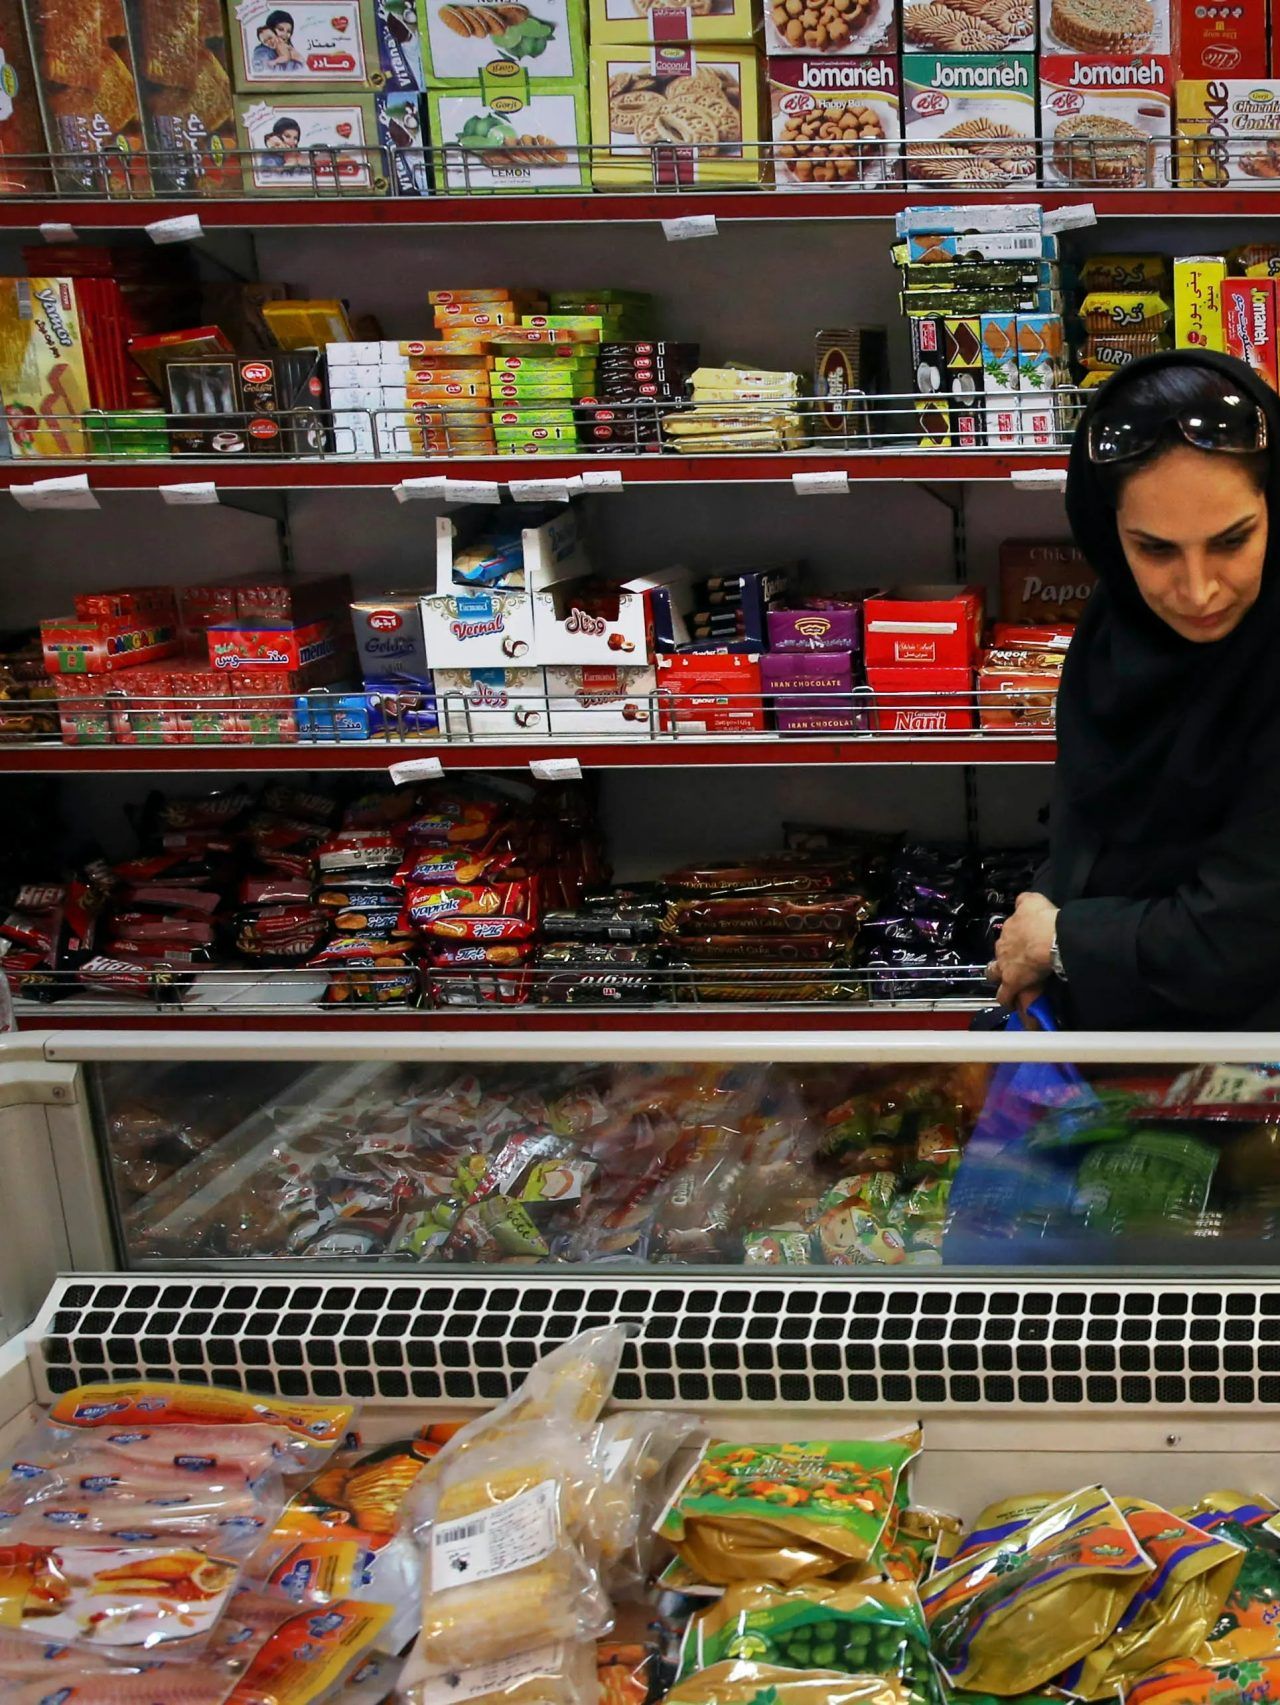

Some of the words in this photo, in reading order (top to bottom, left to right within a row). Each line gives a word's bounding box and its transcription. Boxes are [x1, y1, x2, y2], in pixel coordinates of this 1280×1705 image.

[306, 38, 337, 51] ممتاز
[311, 55, 351, 70] مادر
[655, 60, 689, 71] Coconut
[1203, 47, 1240, 67] Elite
[797, 63, 895, 89] Jomaneh
[930, 61, 1028, 88] Jomaneh
[1068, 63, 1164, 87] Jomaneh
[490, 167, 531, 178] LEMON
[1112, 303, 1144, 326] ترد
[1252, 287, 1269, 346] Jomaneh
[1237, 313, 1253, 365] یسکویت
[1096, 346, 1134, 365] TORD
[452, 613, 505, 640] Vernal
[565, 608, 607, 636] ورنال
[365, 638, 416, 654] Golden
[214, 650, 290, 670] منتوس
[770, 680, 791, 688] IRAN
[792, 679, 842, 688] CHOCOLATE
[787, 721, 808, 729] IRAN
[810, 719, 855, 728] CHOCOLAT
[894, 709, 946, 731] Nani
[409, 899, 459, 920] yaprak
